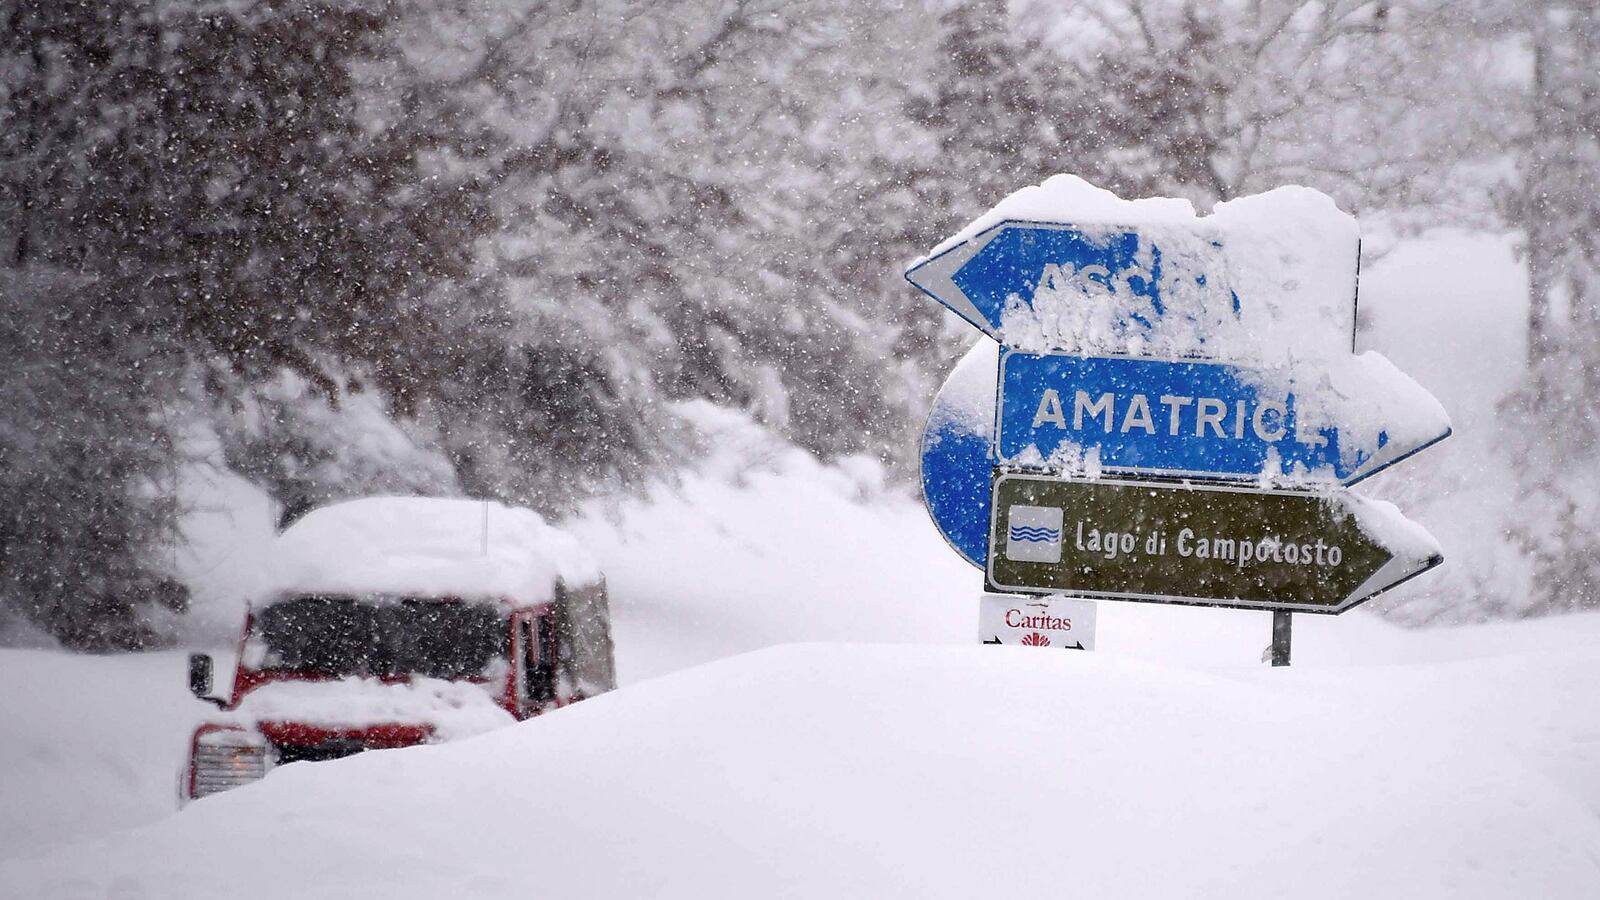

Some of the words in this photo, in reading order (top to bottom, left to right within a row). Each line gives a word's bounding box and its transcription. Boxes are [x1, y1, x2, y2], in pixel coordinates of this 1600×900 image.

[1145, 530, 1166, 556] di
[1177, 527, 1343, 568] Campotosto
[1005, 608, 1072, 631] Caritas
